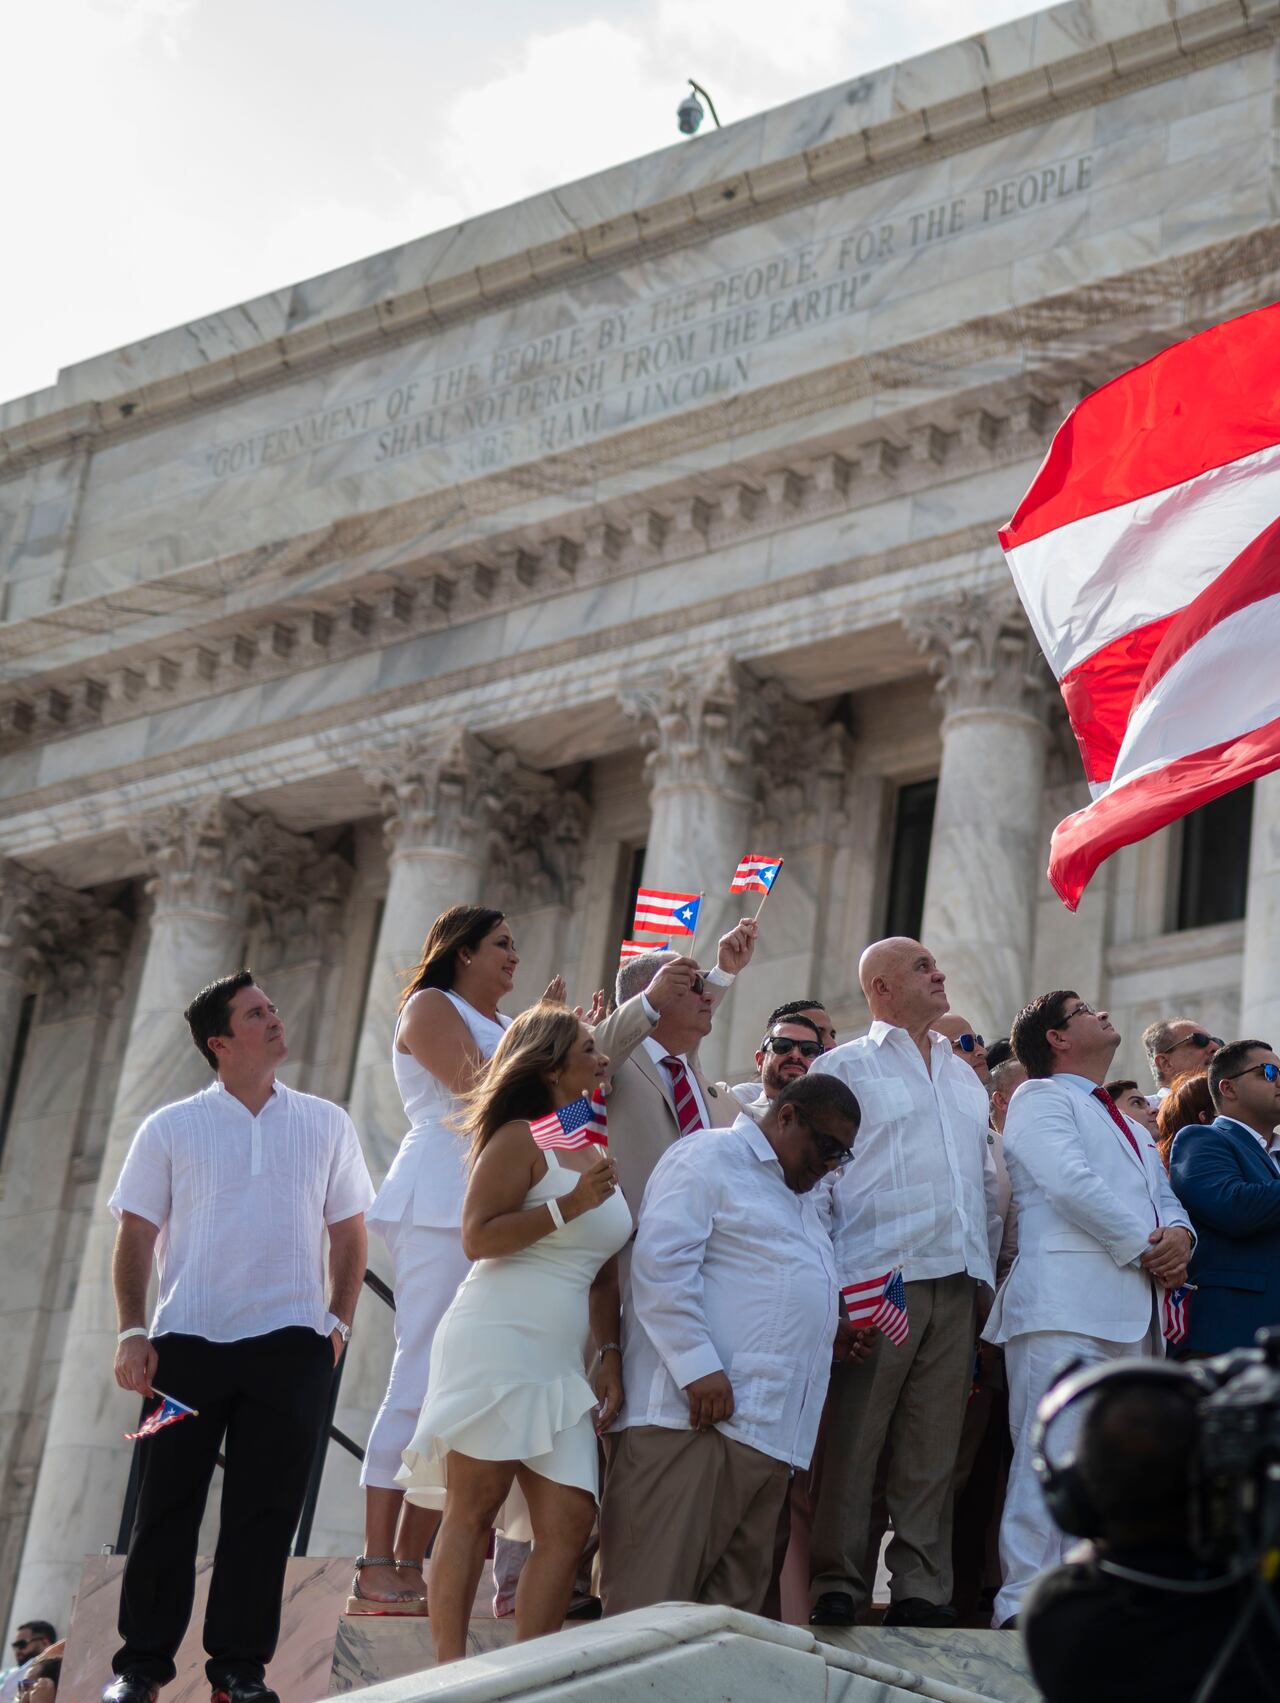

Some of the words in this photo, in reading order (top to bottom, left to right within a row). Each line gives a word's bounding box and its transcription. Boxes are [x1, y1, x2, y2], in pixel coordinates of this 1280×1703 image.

[386, 382, 419, 421] OF
[432, 363, 480, 405] THE
[598, 311, 633, 350] BY
[651, 289, 697, 332] THE
[838, 224, 894, 271] FOR
[909, 199, 966, 246] THE
[982, 155, 1094, 222] PEOPLE
[375, 408, 449, 462] SHALL
[462, 390, 513, 430] NOT
[516, 359, 605, 416] PERISH
[621, 330, 695, 383] FROM
[707, 308, 759, 354] THE
[622, 352, 752, 423] LINCOLN
